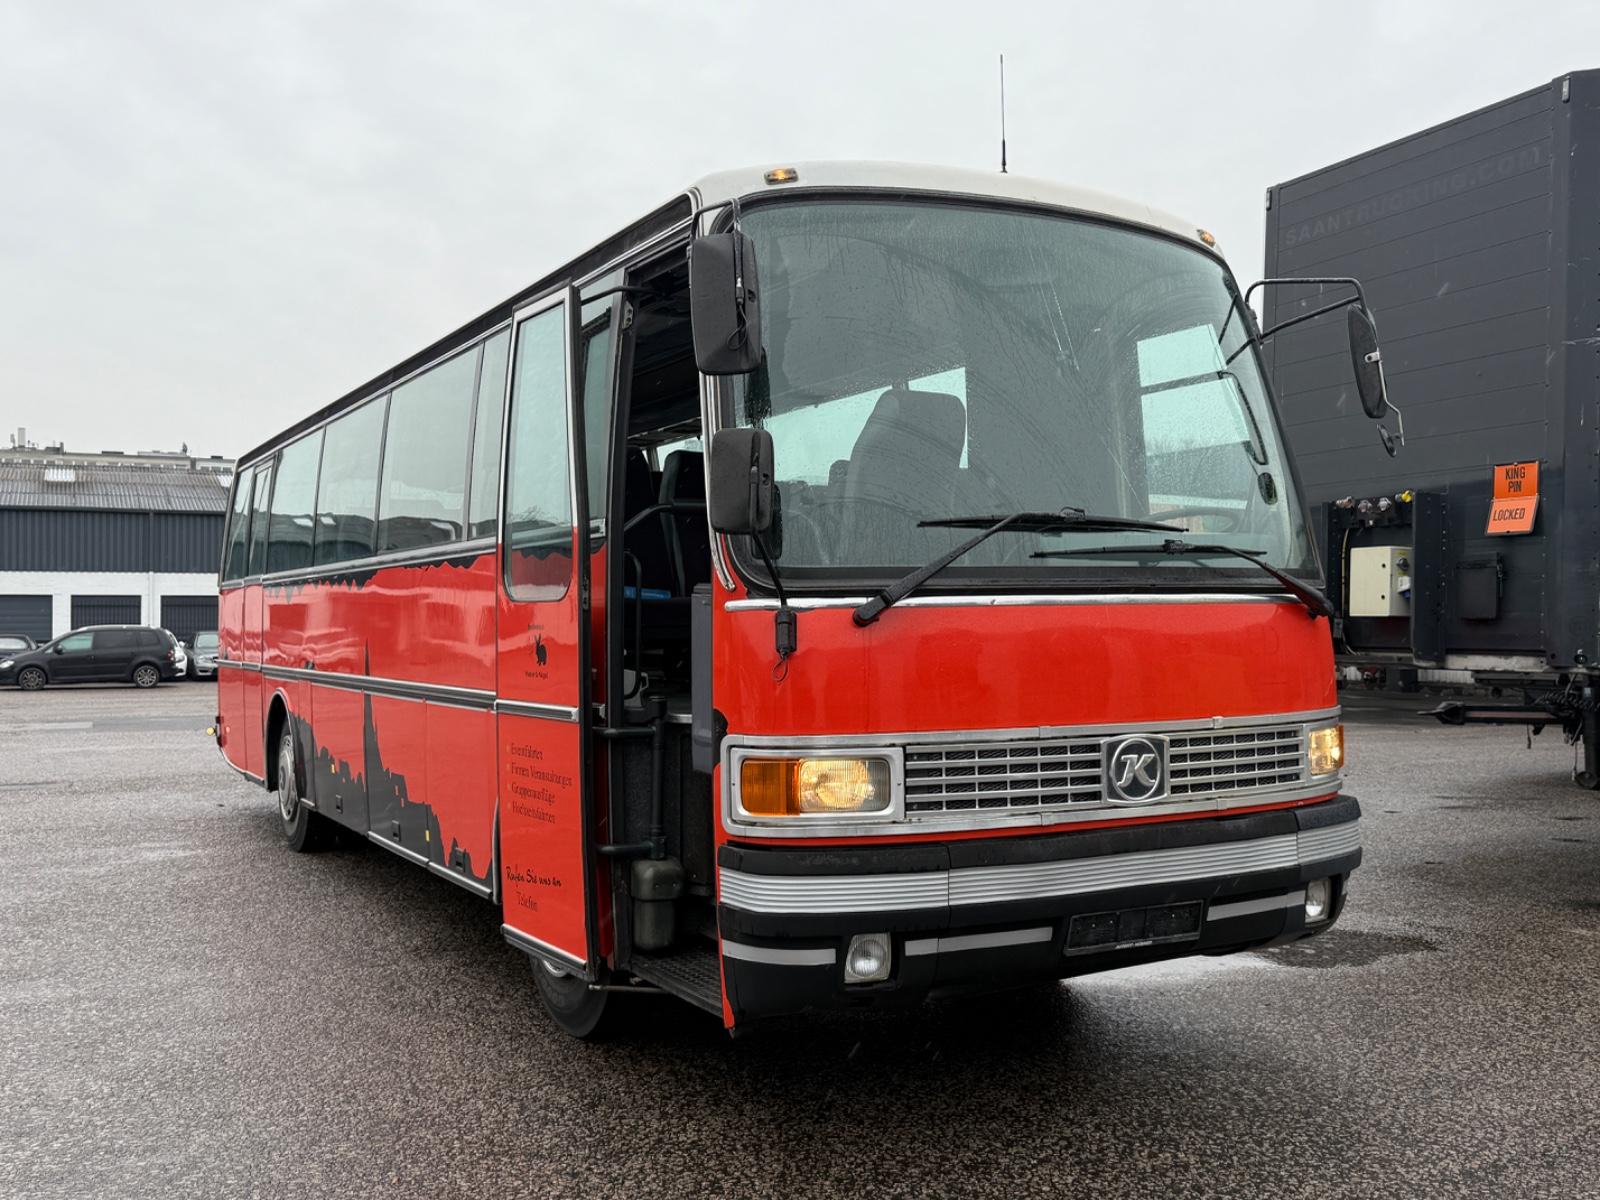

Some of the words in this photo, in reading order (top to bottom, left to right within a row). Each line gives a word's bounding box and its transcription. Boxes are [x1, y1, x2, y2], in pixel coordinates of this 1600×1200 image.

[1285, 147, 1541, 246] SAANTRUCKING.COM
[1506, 467, 1525, 480] KING
[1509, 481, 1521, 492] PIN
[1493, 508, 1525, 521] LOCKED
[526, 868, 538, 886] Sie
[538, 874, 552, 887] uns
[552, 875, 562, 887] an
